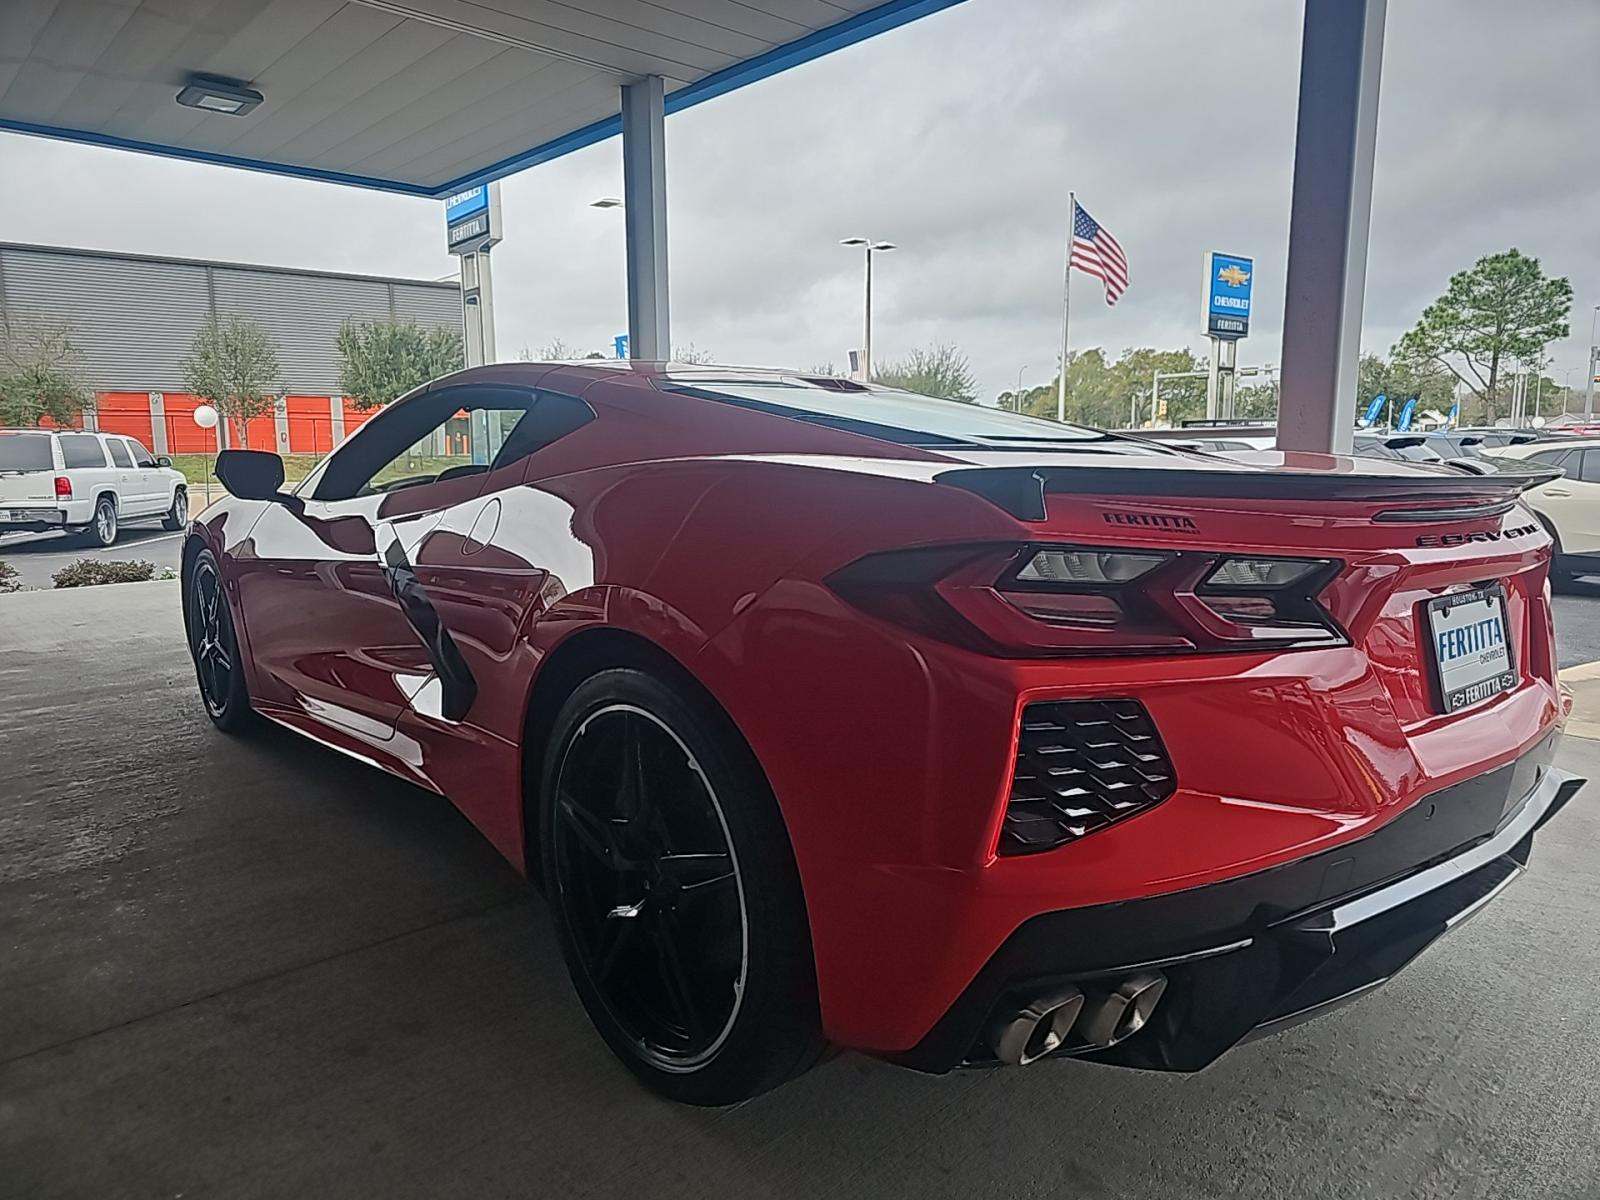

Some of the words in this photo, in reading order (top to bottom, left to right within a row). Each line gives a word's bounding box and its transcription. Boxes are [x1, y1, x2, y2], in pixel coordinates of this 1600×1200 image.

[452, 220, 480, 242] FERTITTA
[1214, 296, 1249, 309] CHEVROLET
[1217, 320, 1243, 331] FERTITTA
[1103, 513, 1197, 529] FERTITTA
[1438, 617, 1503, 663] FERTITTA
[1479, 646, 1505, 665] CHEVROLET
[1465, 677, 1502, 704] FERTITTA
